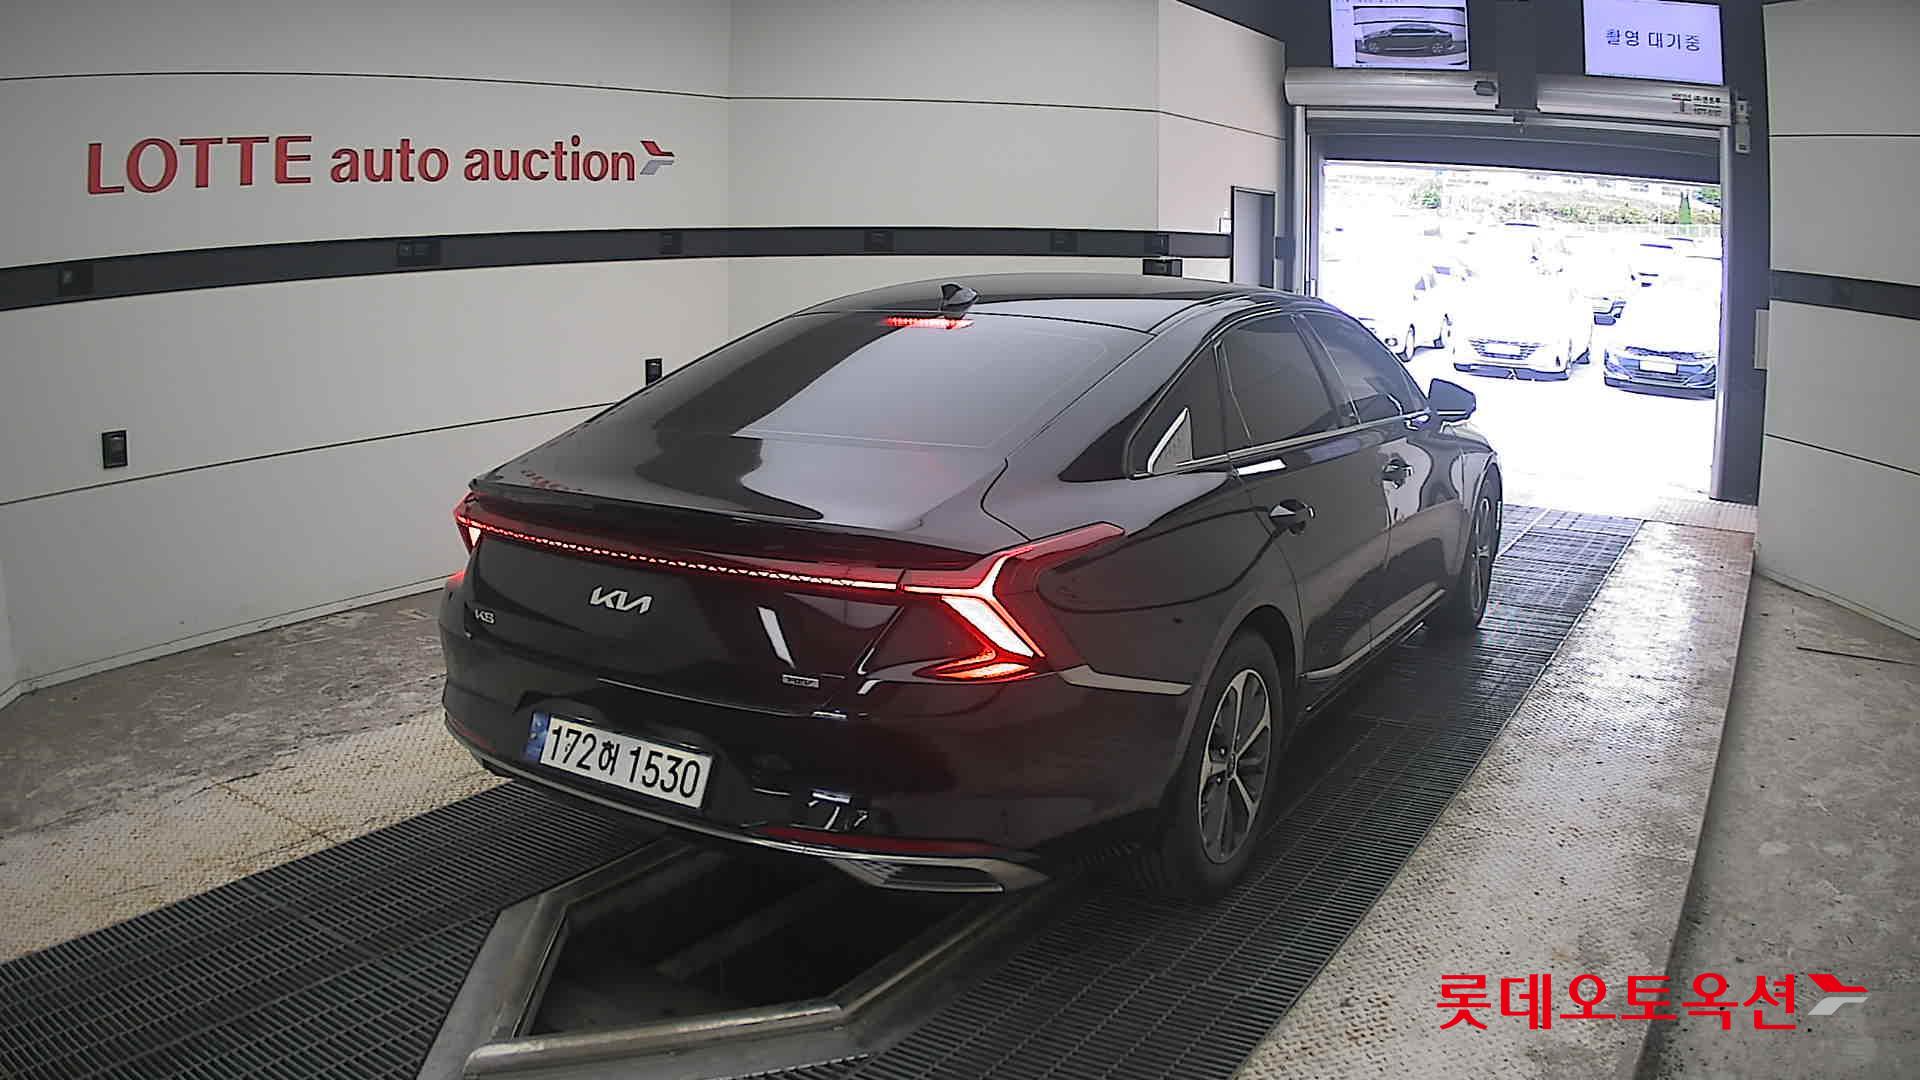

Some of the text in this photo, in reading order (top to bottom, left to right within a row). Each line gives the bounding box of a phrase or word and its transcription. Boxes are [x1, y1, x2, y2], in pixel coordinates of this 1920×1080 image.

[87, 134, 636, 195] LOTTE auto auction
[590, 586, 653, 615] KIA
[629, 746, 701, 799] 1530
